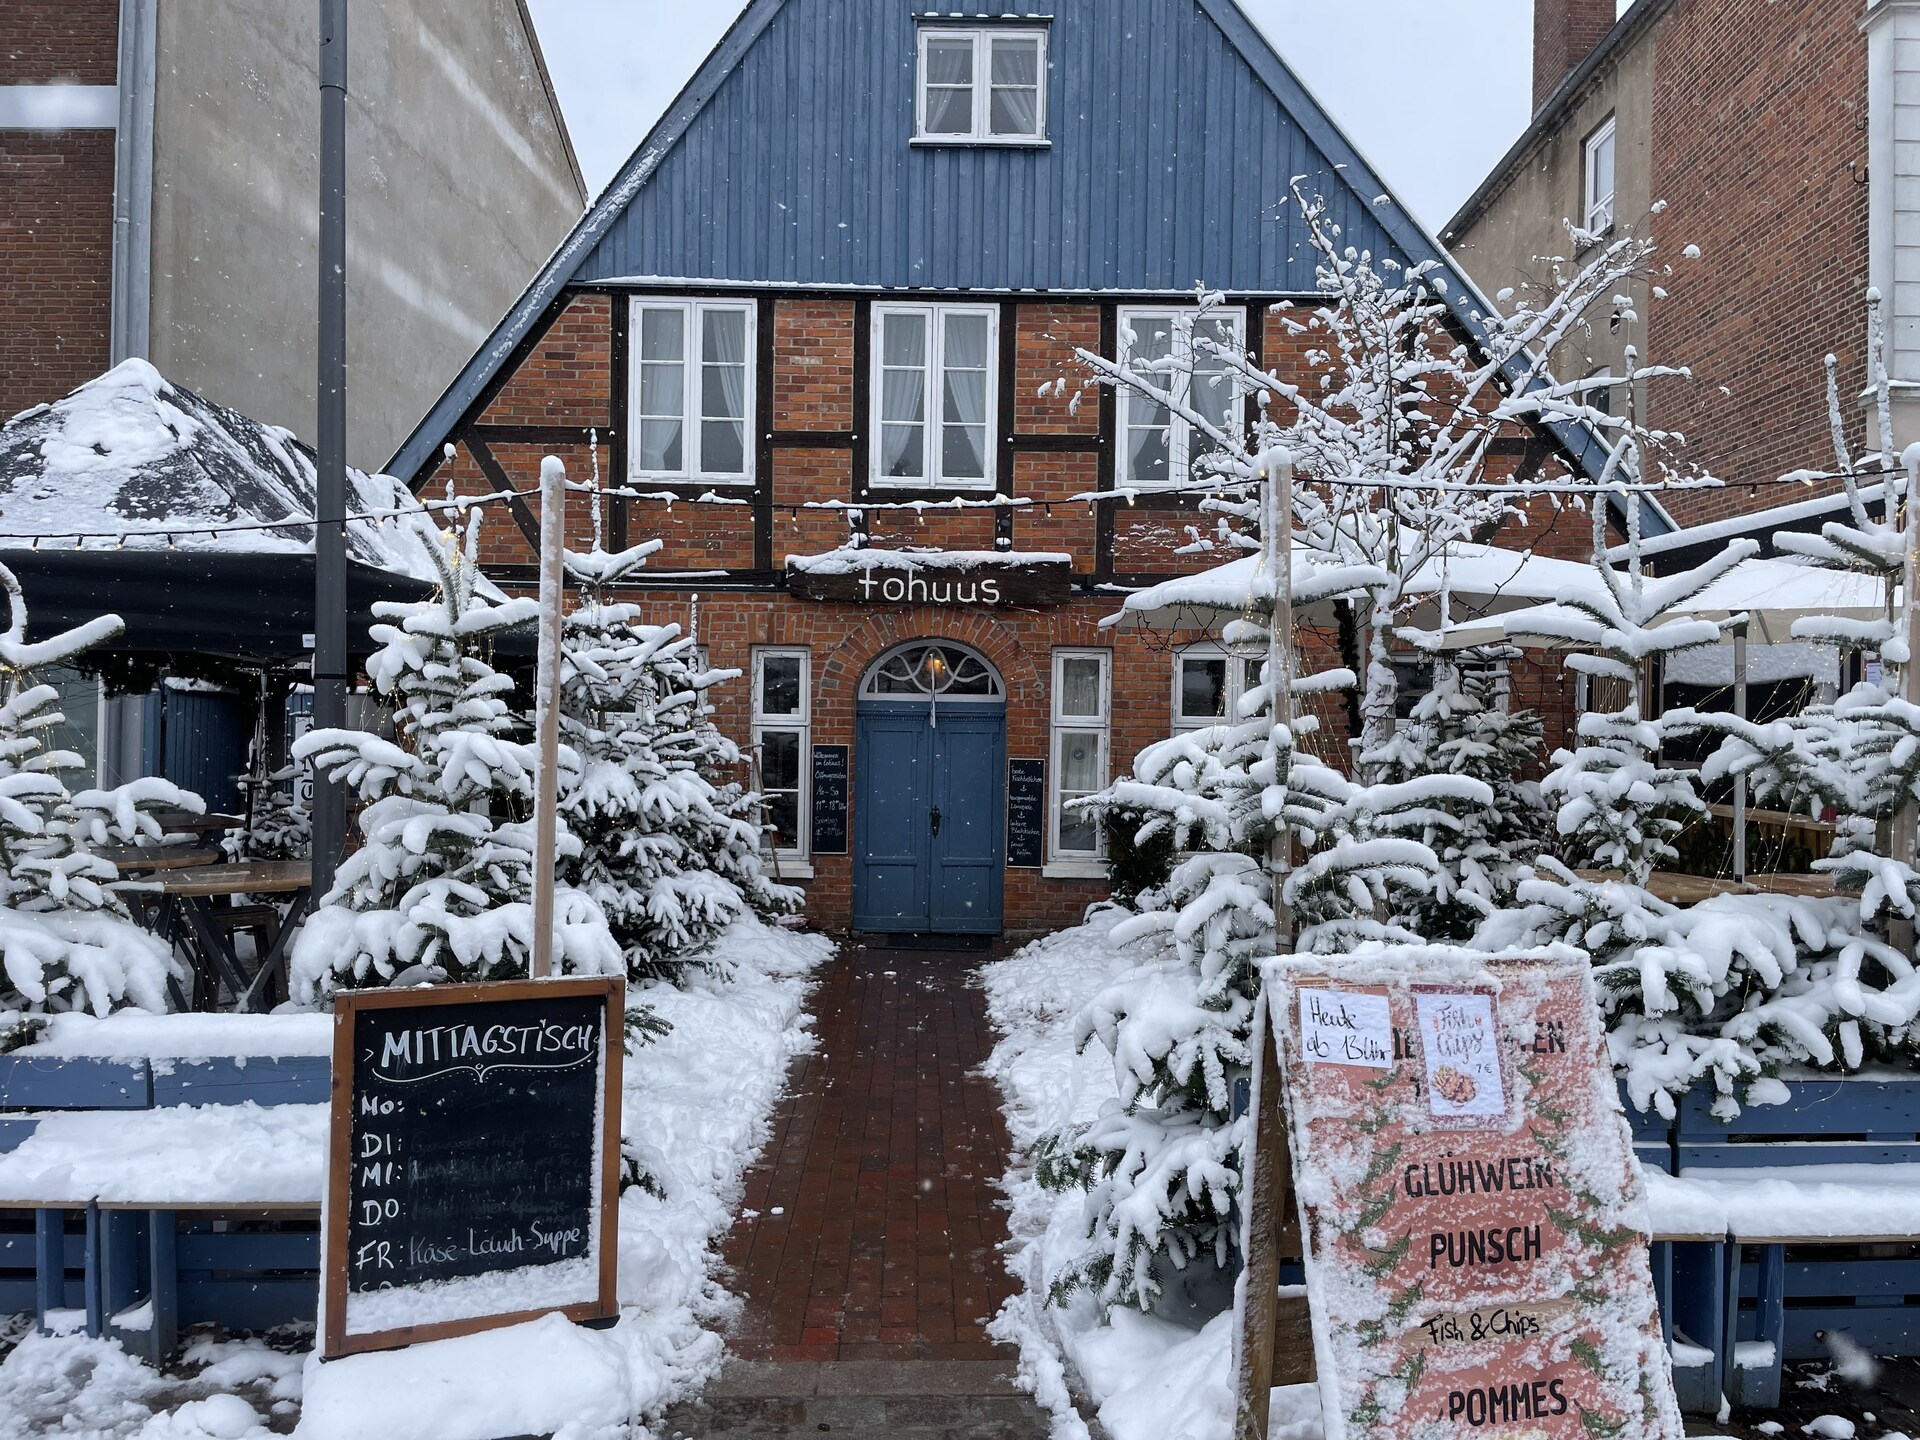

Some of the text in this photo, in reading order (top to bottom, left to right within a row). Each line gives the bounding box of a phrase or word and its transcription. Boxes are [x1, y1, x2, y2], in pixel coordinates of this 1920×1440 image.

[858, 567, 1000, 603] tohuus
[1015, 681, 1046, 700] 13
[1309, 996, 1363, 1030] Heute
[1435, 1000, 1475, 1031] Fish
[381, 1020, 594, 1068] MITTAGSTISCH
[1306, 1031, 1329, 1058] ab
[1436, 1028, 1485, 1064] Chips
[1404, 1151, 1554, 1198] GLÜHWEIN
[1430, 1225, 1541, 1269] PUNSCH
[1420, 1309, 1540, 1344] Fish & Chips
[1448, 1378, 1568, 1427] POMMES
